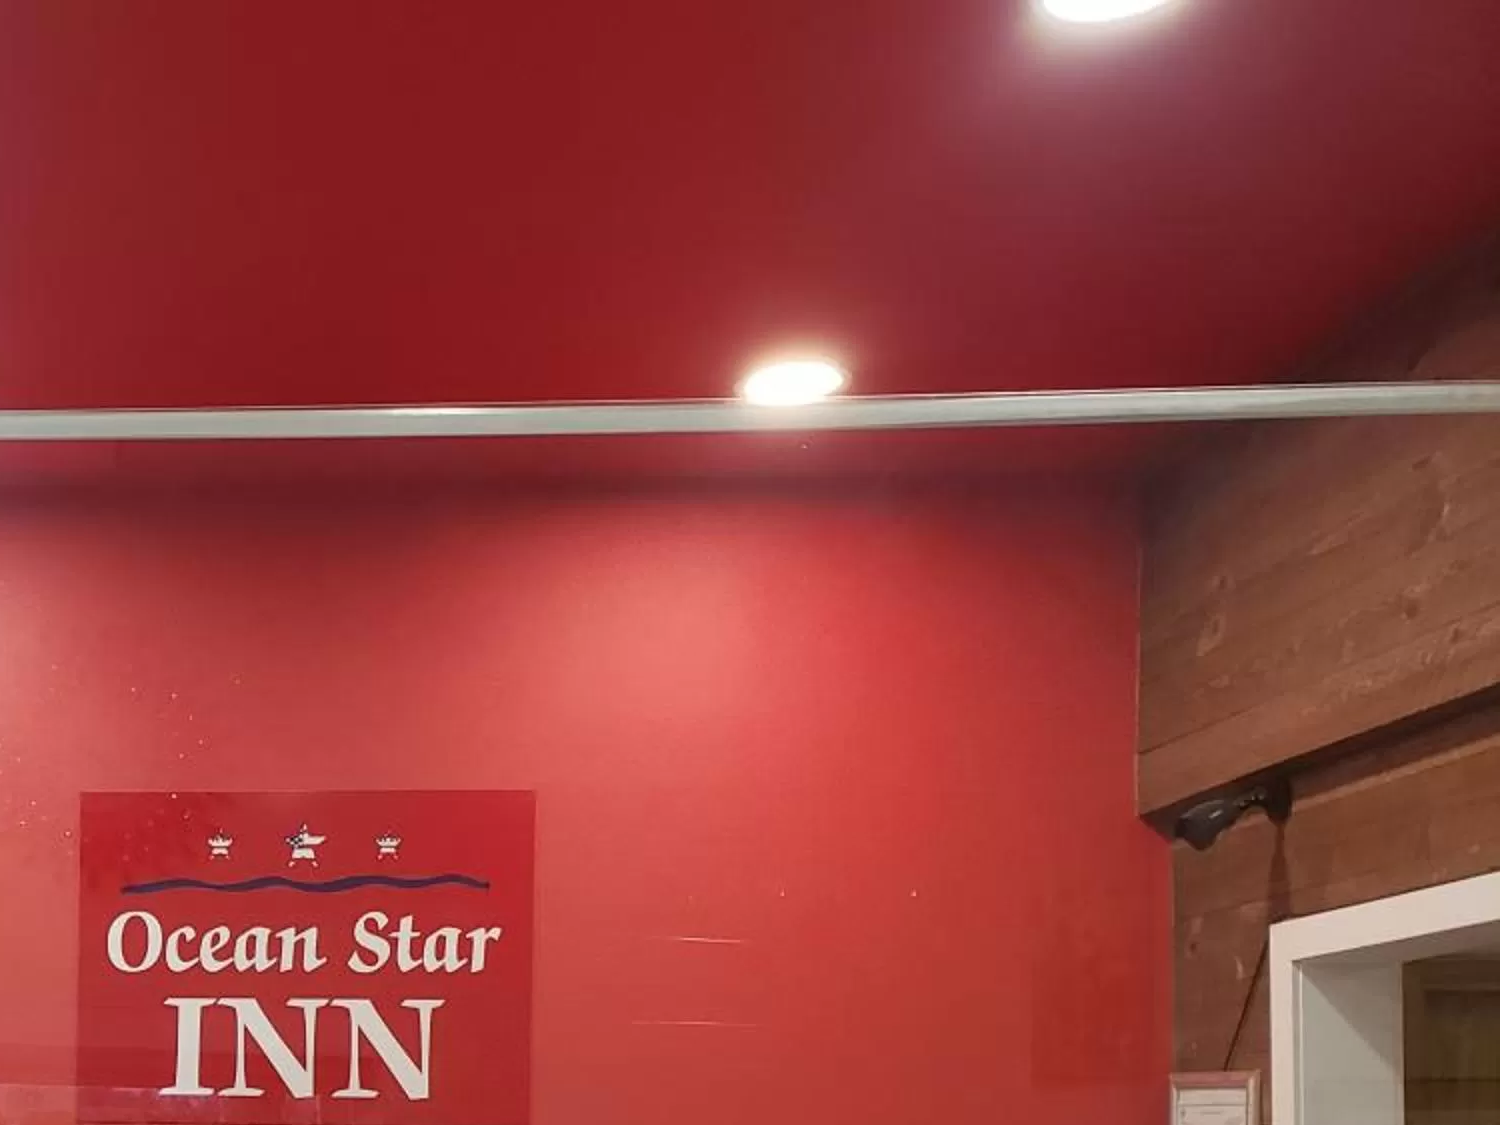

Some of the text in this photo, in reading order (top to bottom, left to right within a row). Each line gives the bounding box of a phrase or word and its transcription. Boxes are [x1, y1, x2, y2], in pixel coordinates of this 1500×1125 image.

[107, 911, 502, 974] Ocean Star
[158, 997, 446, 1100] INN
